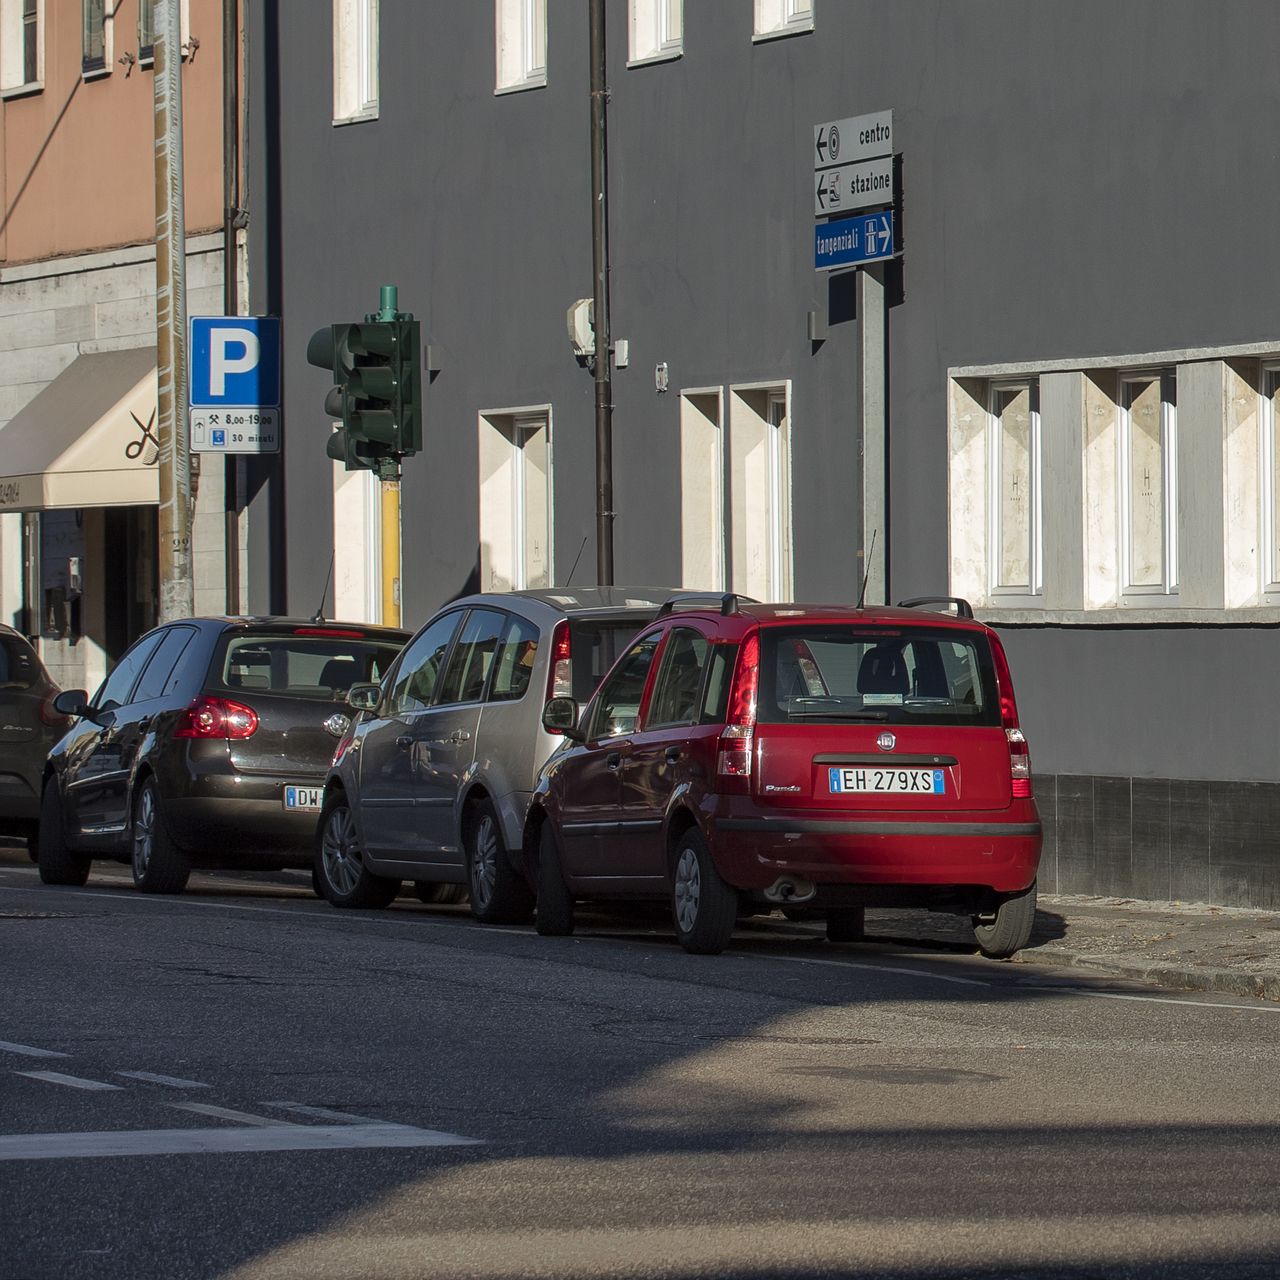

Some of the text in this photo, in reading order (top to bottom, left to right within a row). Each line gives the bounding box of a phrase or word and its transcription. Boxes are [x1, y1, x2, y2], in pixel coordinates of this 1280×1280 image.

[859, 123, 890, 145] centro
[851, 172, 890, 195] stazione
[817, 228, 859, 256] tangenziali
[210, 328, 260, 396] P
[232, 433, 274, 442] 30 minuti
